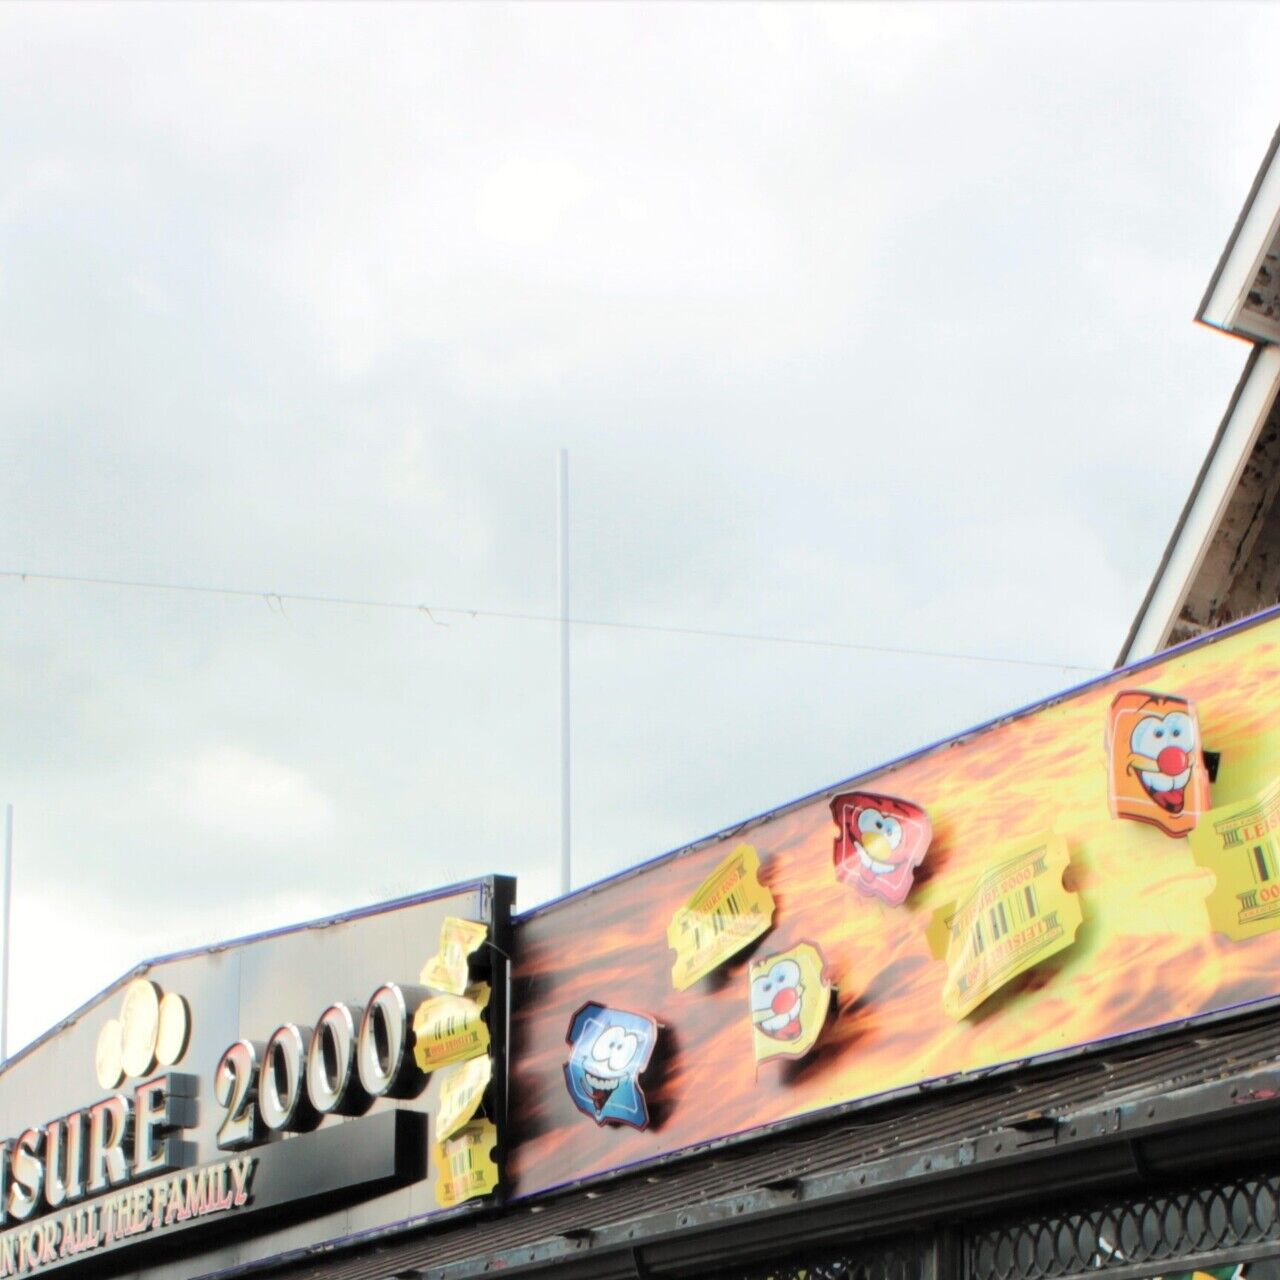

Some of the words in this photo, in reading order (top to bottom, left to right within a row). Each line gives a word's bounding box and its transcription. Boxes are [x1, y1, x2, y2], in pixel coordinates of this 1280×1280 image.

[214, 981, 408, 1151] 2000
[17, 1219, 58, 1274] FOR
[59, 1204, 100, 1258] ALL
[102, 1186, 152, 1248] THE
[152, 1155, 252, 1229] FAMILY
